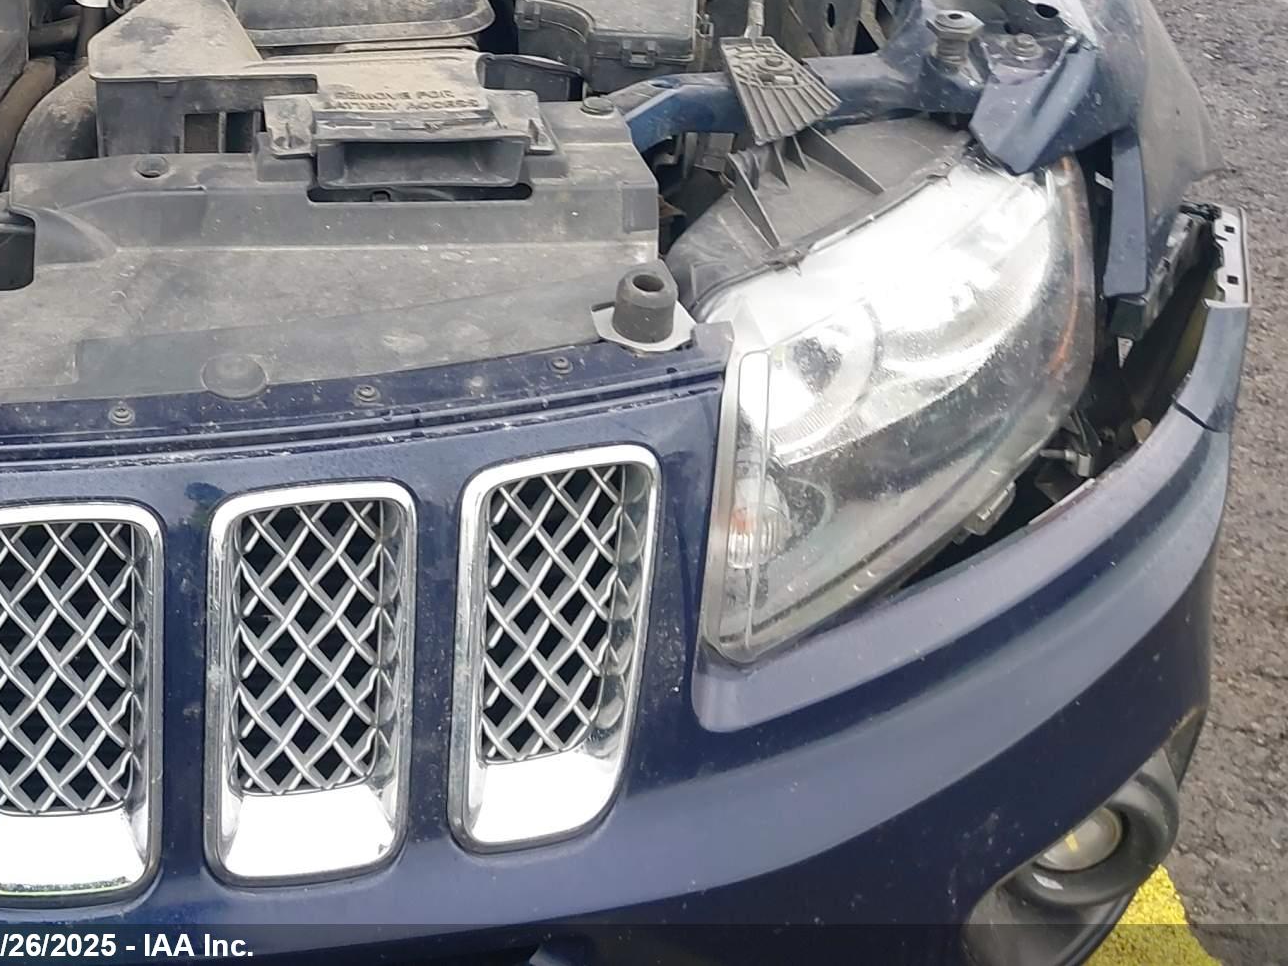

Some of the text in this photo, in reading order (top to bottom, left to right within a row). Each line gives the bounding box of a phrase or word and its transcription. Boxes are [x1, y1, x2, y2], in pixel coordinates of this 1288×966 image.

[334, 89, 456, 101] REMOVE FOR
[406, 99, 480, 111] ACCESS
